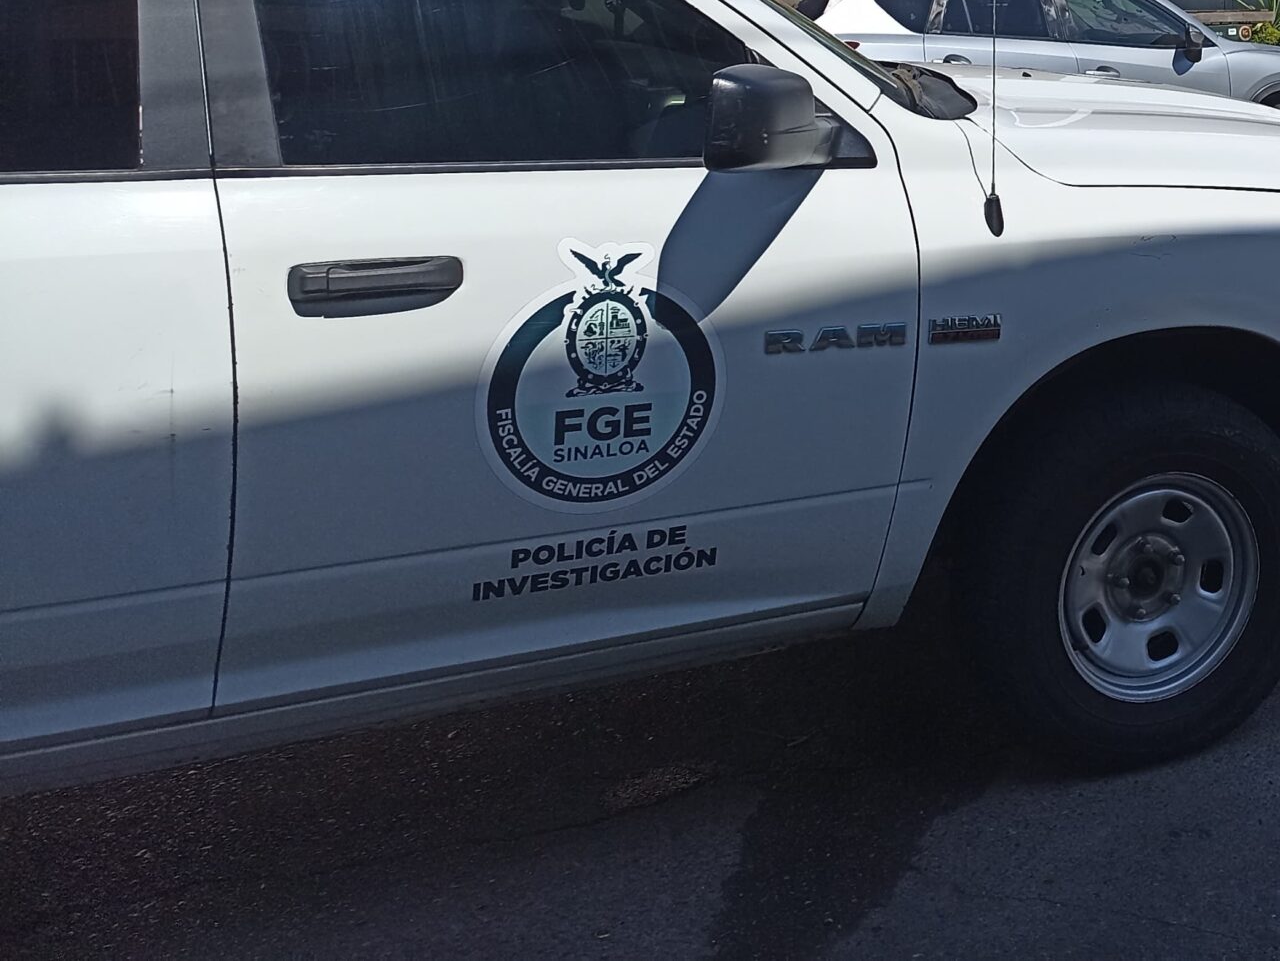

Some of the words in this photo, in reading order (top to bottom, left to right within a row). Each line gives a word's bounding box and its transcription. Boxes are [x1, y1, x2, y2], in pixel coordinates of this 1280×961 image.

[764, 322, 907, 355] RAM
[928, 314, 1002, 332] HEMI
[495, 406, 539, 482] FISCALÍA
[541, 475, 630, 498] GENERAL
[632, 457, 670, 485] DEL
[666, 389, 708, 458] ESTADO
[553, 402, 653, 446] FGE
[553, 440, 650, 463] SINALOA
[510, 530, 639, 569] POLICÍA
[645, 524, 687, 550] DE
[471, 545, 718, 602] INVESTIGACIÓN
